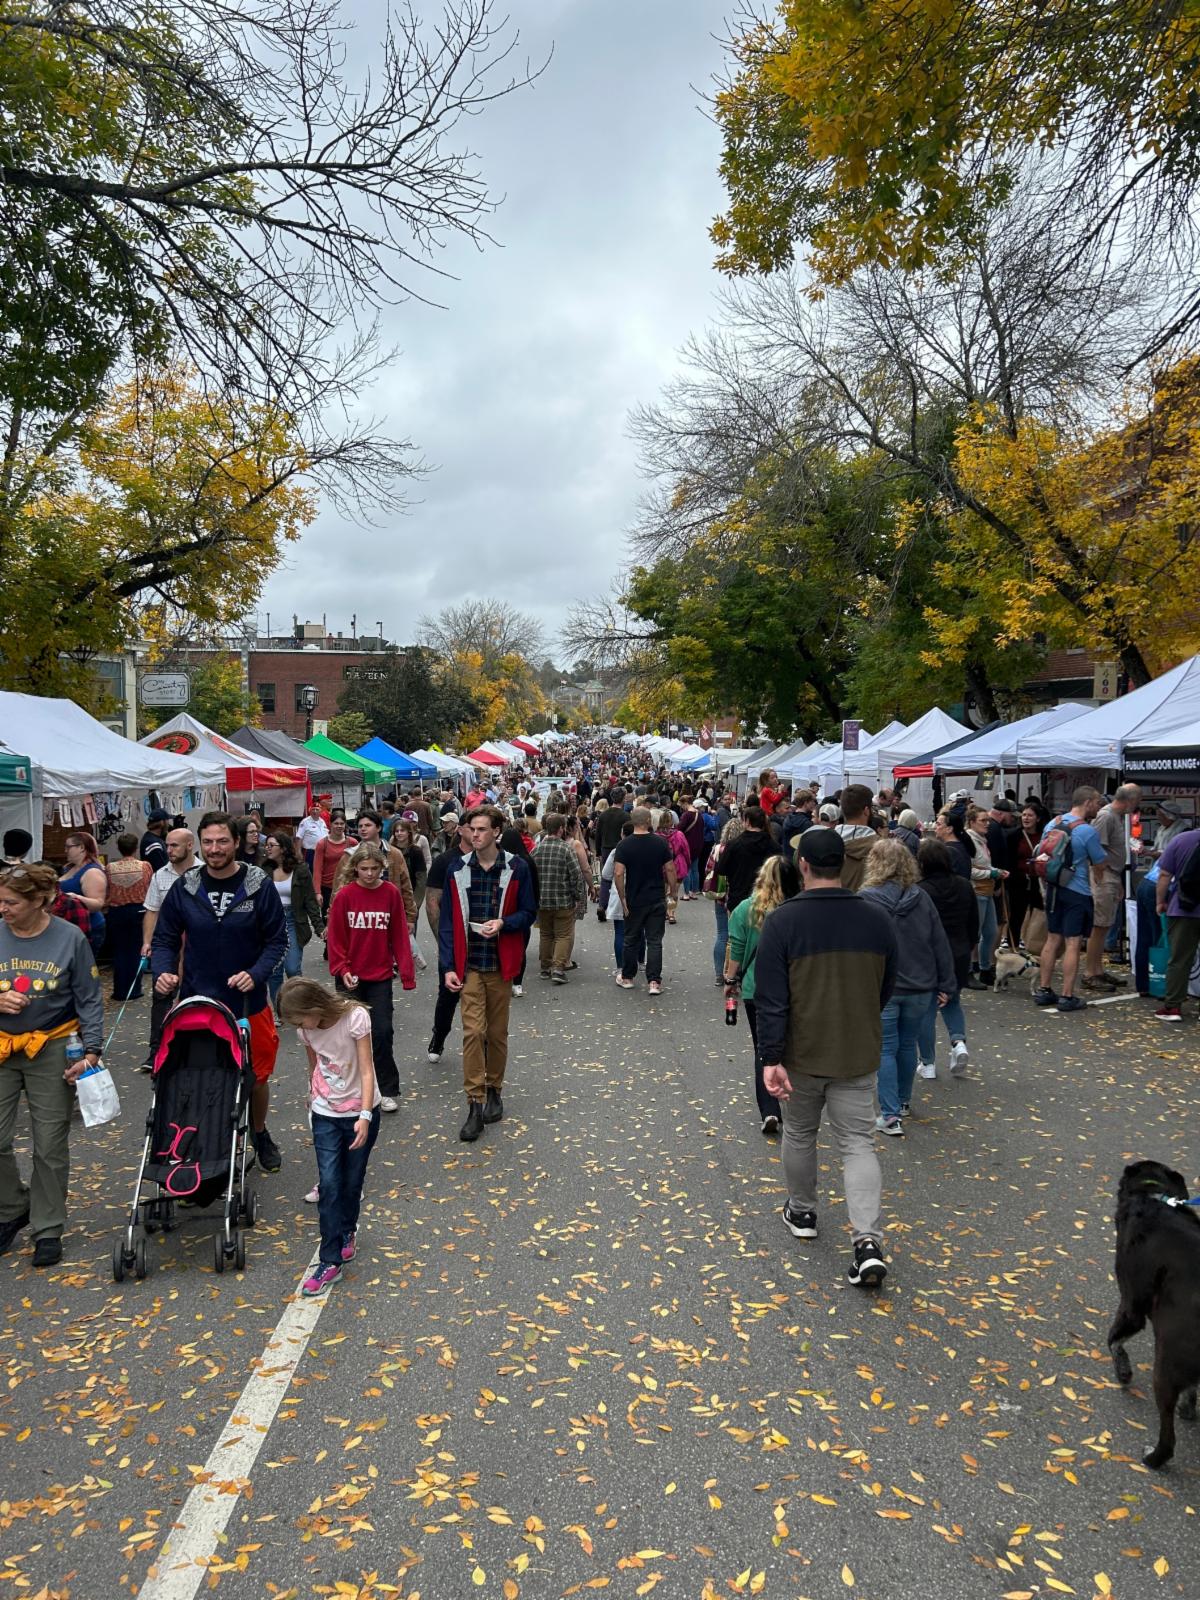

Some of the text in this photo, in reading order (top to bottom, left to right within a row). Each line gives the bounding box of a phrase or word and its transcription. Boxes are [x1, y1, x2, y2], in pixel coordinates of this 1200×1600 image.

[1125, 758, 1197, 771] PUBLIC INDOOR RANGE
[347, 911, 391, 930] BATES
